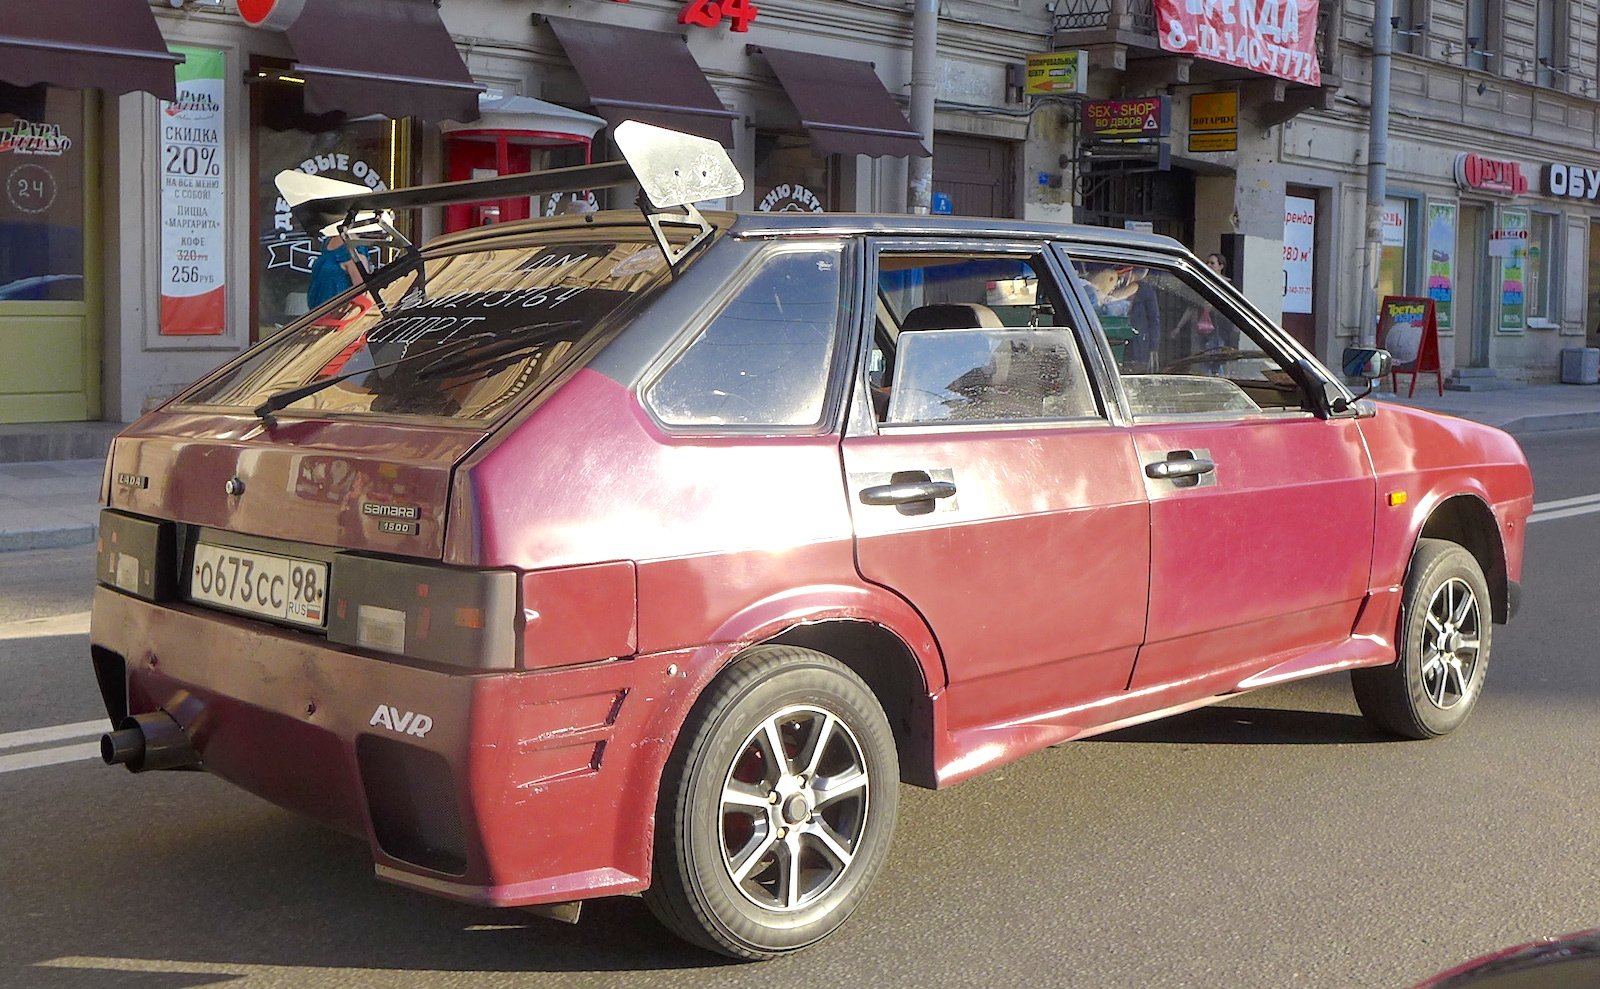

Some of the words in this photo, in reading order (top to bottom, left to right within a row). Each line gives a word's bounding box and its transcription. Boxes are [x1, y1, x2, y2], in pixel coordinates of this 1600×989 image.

[1088, 105, 1111, 117] SEX
[1120, 102, 1155, 116] SHOP
[13, 118, 61, 139] PAPA
[165, 126, 218, 143] СКИДКА
[166, 145, 220, 176] 20%
[18, 179, 43, 198] 24
[166, 178, 177, 188] НА
[179, 179, 193, 188] ВСЕ
[195, 179, 219, 189] МЕНЮ
[177, 205, 208, 217] ПИЦЦА
[1285, 210, 1313, 225] ренда
[181, 237, 206, 247] КОФЕ
[177, 249, 197, 261] 320
[171, 265, 199, 283] 256
[119, 473, 142, 487] LADA
[383, 522, 409, 532] 1500
[292, 566, 317, 603] 98
[288, 601, 307, 616] RUS
[369, 704, 433, 738] AVR
